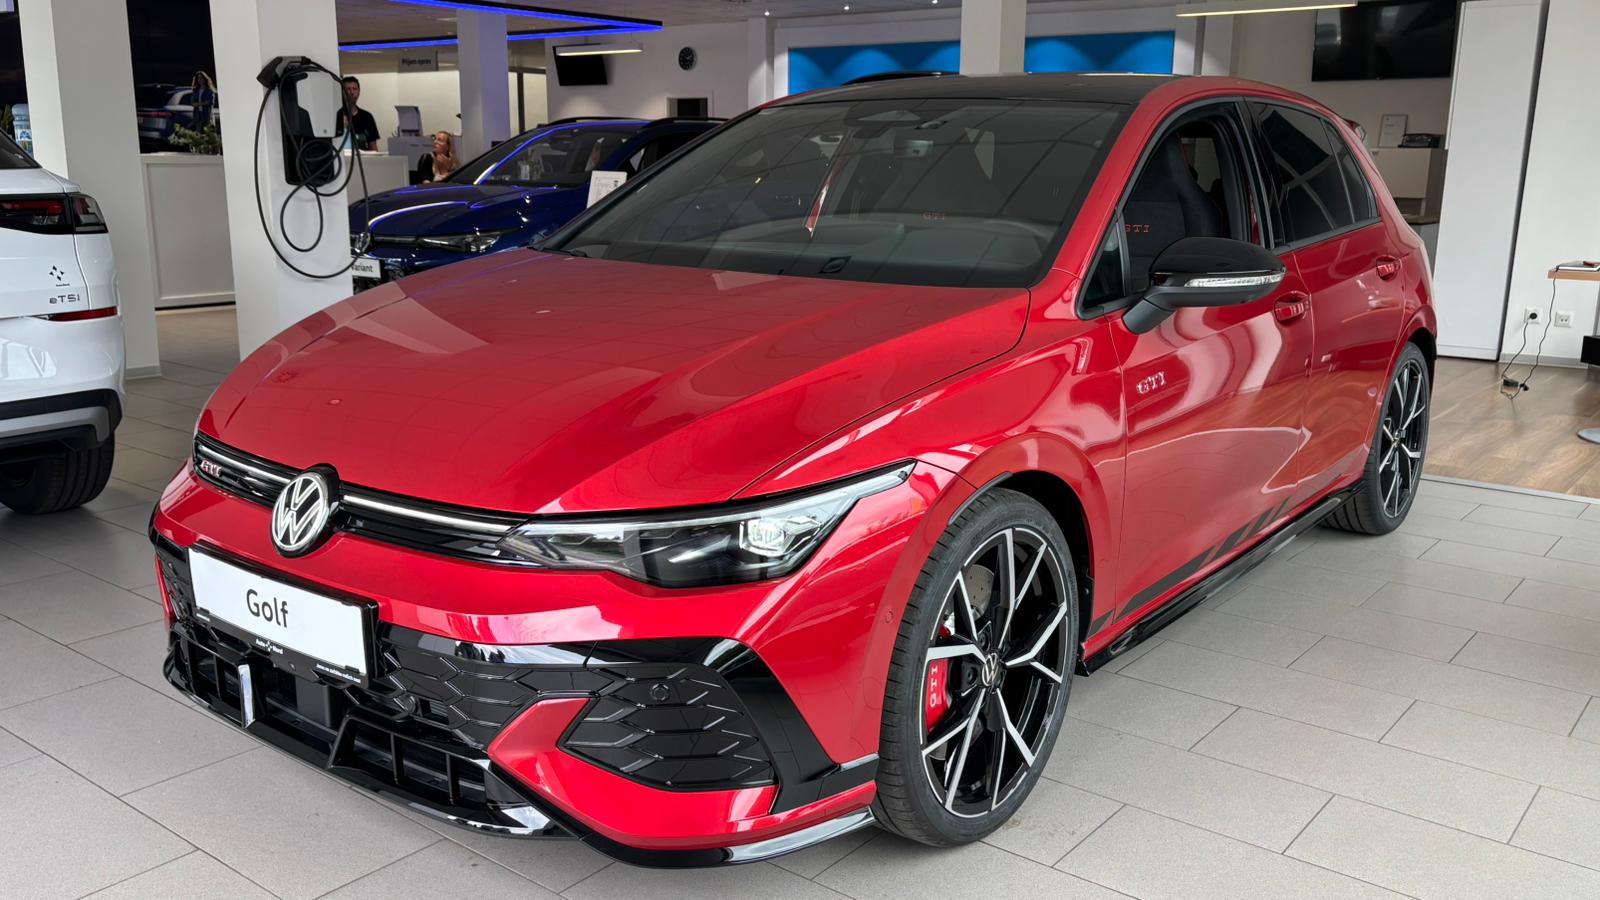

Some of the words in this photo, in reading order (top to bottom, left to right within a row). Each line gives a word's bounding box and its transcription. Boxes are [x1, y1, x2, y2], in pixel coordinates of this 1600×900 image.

[1136, 371, 1166, 394] GTI
[200, 459, 222, 478] GTI
[271, 473, 325, 550] VW
[246, 588, 288, 628] Golf
[929, 665, 938, 708] GTI
